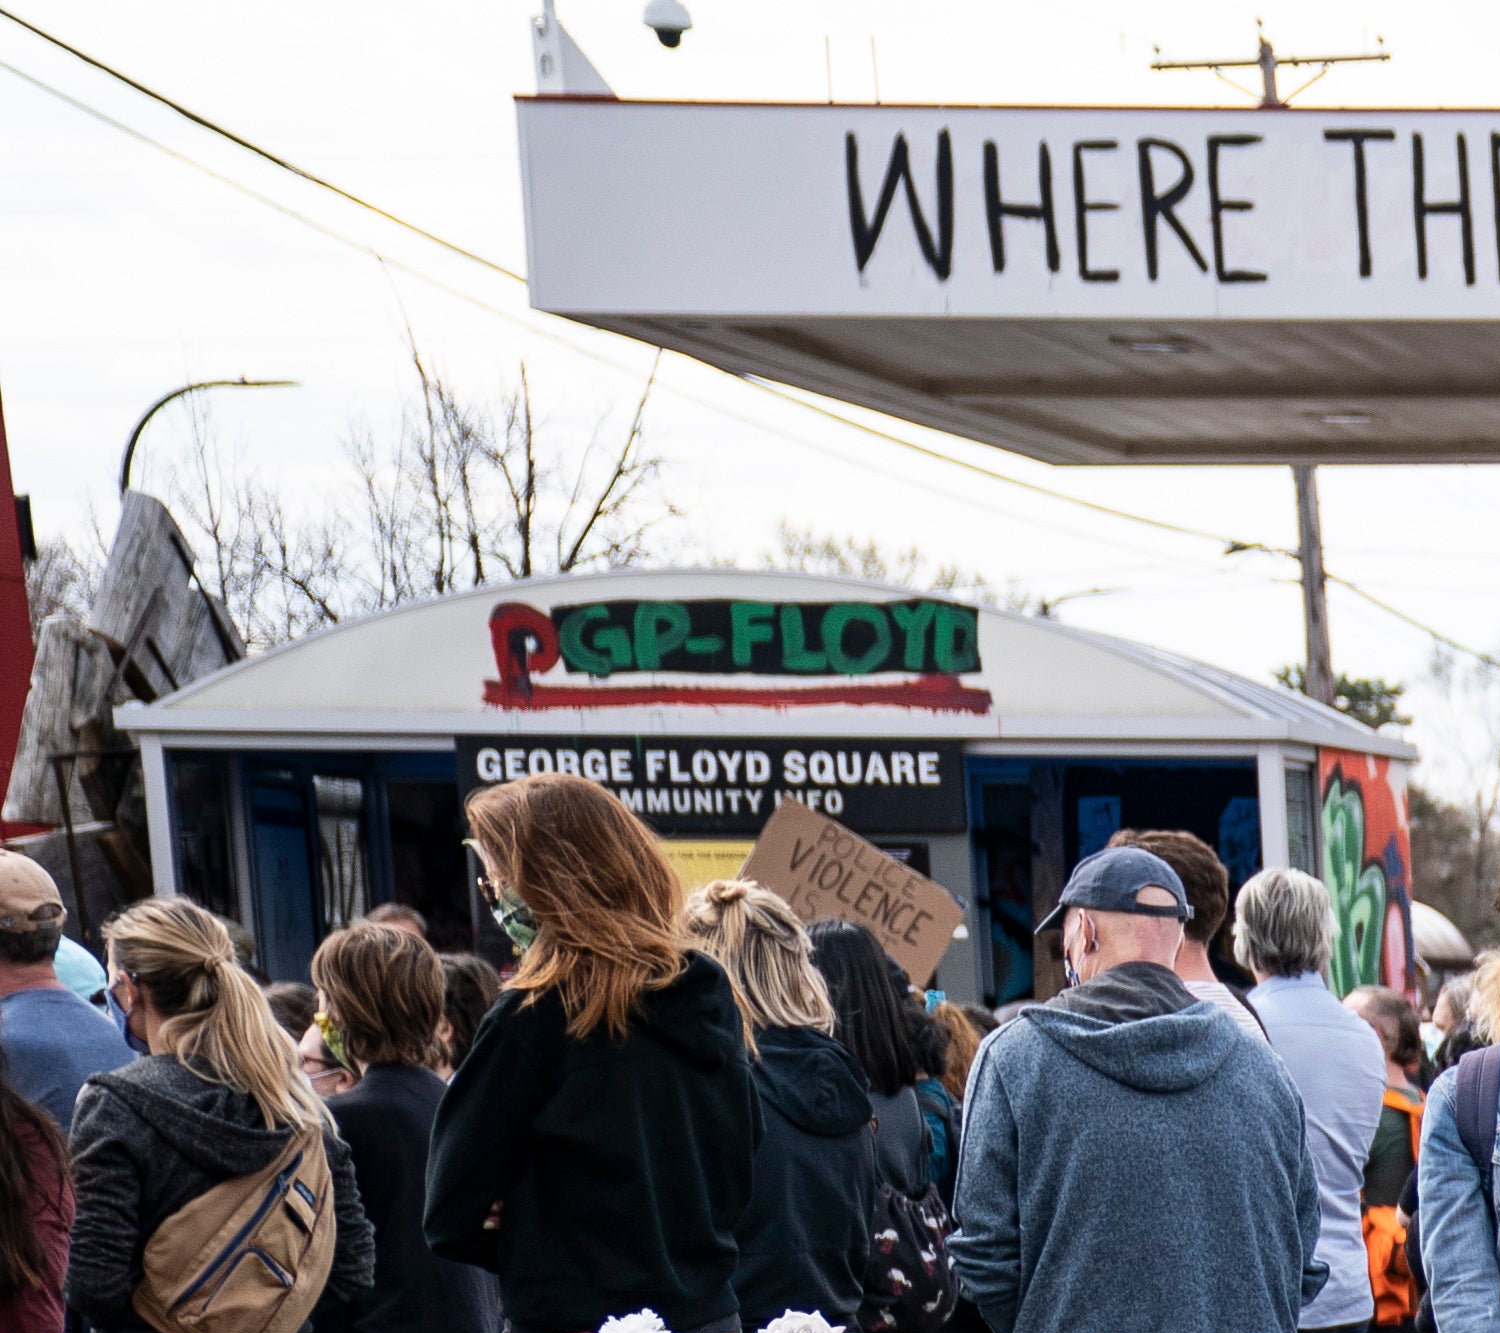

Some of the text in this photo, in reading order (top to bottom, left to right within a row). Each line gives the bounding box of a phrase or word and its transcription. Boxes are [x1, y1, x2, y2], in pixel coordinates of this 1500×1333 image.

[846, 127, 1267, 283] WHERE
[476, 747, 940, 785] GEORGE FLOYD SQUARE
[774, 789, 843, 815] IFO
[789, 838, 933, 947] VIOLENCE
[817, 823, 917, 901] POLICE
